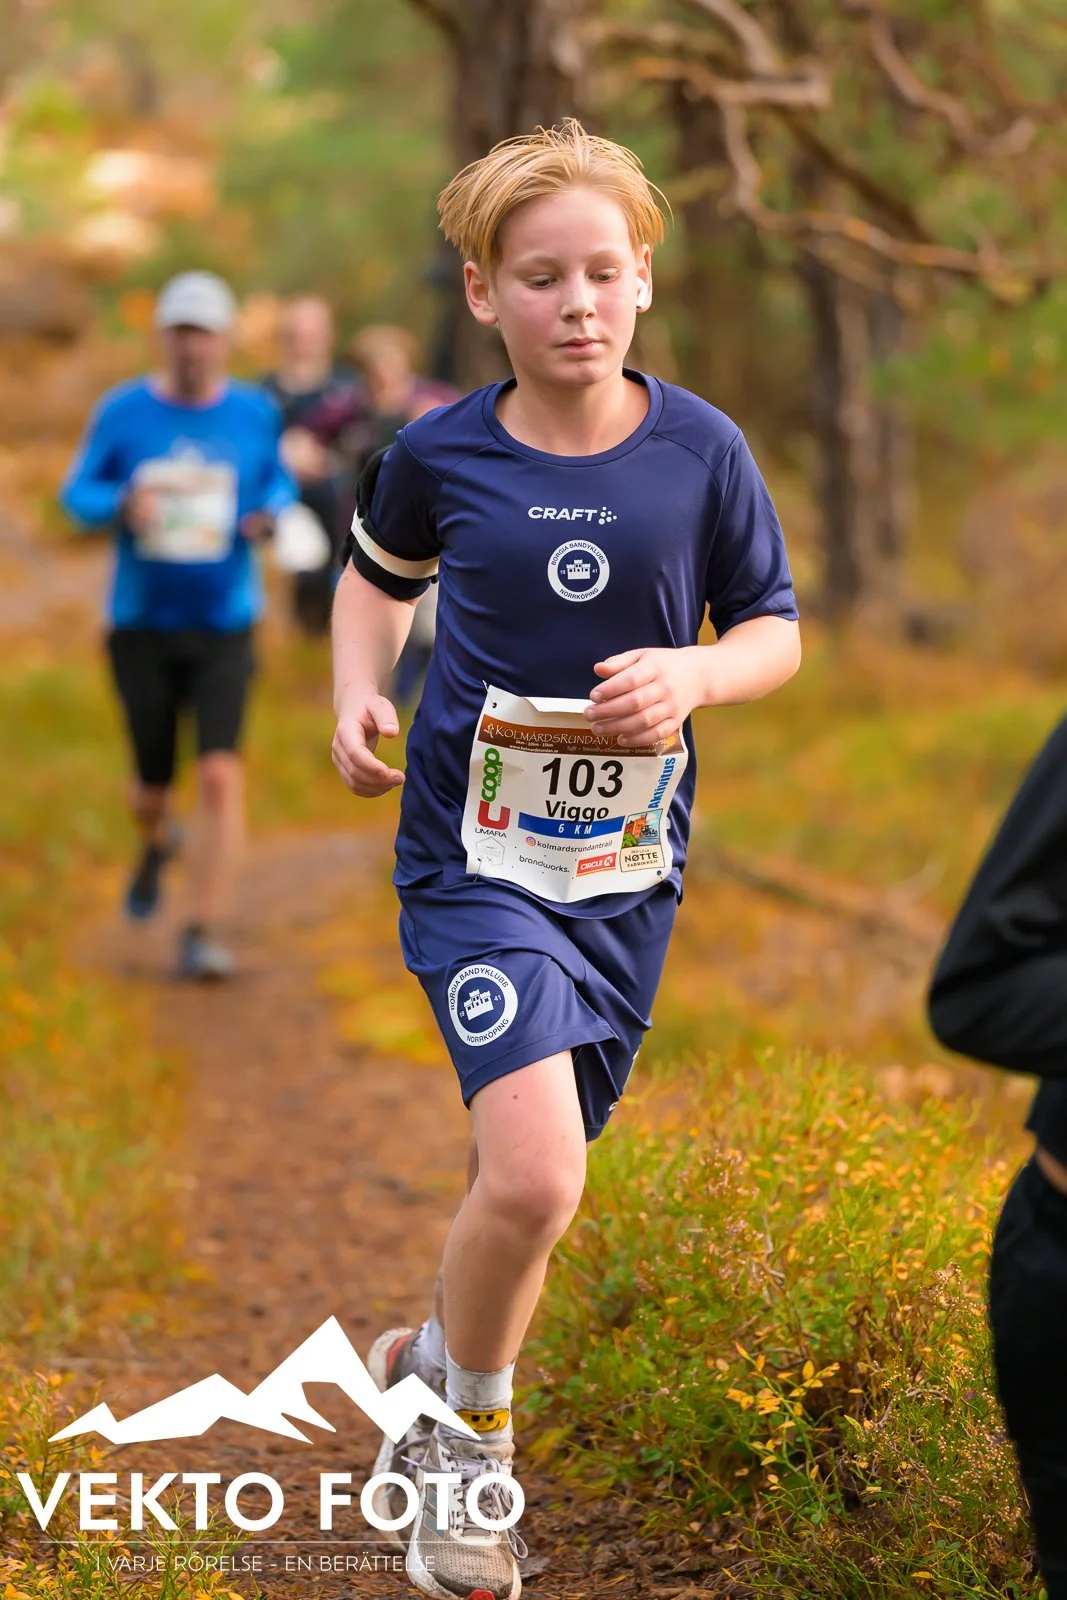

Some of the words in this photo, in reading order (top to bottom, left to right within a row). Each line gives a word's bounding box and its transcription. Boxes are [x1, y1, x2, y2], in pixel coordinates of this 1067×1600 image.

[527, 506, 598, 522] CRAFT
[551, 545, 569, 566] BORGIA
[569, 542, 606, 565] BANDYKLUBB
[559, 587, 599, 600] NORRKÖPING
[481, 748, 503, 802] coop
[542, 757, 624, 798] 103
[648, 757, 676, 809] Aktivitus
[545, 800, 610, 823] Viggo
[474, 827, 507, 838] UMARA
[558, 823, 565, 833] 6
[537, 840, 613, 853] kolmardsrundantrail
[519, 855, 570, 873] brandworks.
[580, 860, 604, 870] CIRCLE
[624, 852, 658, 863] NØTTE
[449, 980, 461, 1011] BORGIA
[459, 967, 509, 988] BANDYKLUBB
[493, 994, 502, 1002] 41
